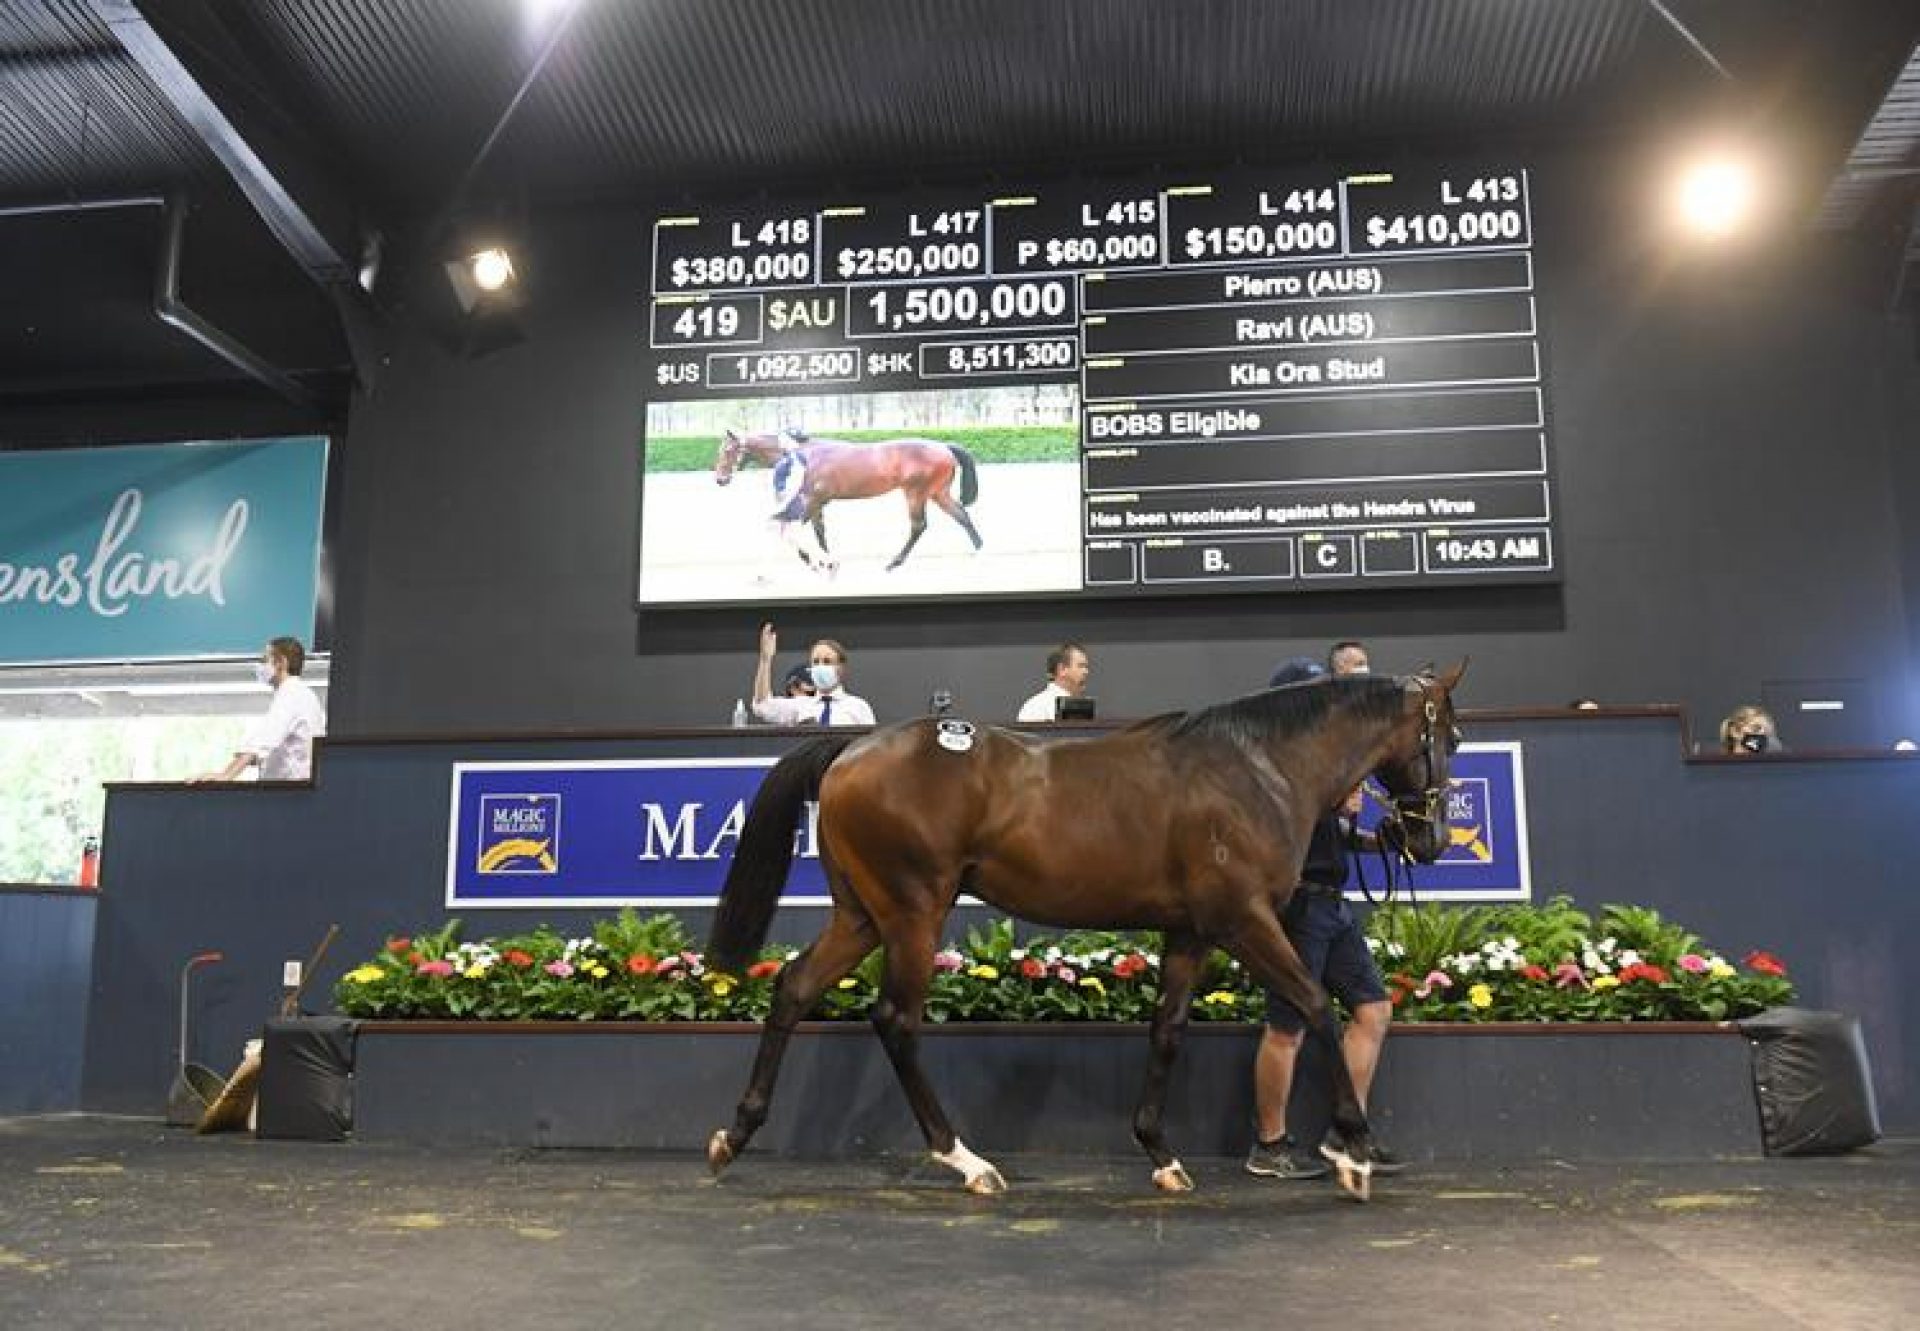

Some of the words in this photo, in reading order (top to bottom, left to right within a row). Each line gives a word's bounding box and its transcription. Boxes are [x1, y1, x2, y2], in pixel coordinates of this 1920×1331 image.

[1259, 193, 1279, 215] L
[1284, 188, 1334, 213] 414
[1441, 181, 1462, 204] L
[1466, 177, 1519, 202] 413
[909, 214, 927, 237] L
[934, 211, 979, 234] 417
[1082, 204, 1101, 226] L
[1106, 200, 1156, 223] 415
[732, 222, 750, 247] L
[757, 219, 810, 245] 418
[1185, 221, 1336, 259] $150,000
[1366, 210, 1521, 248] $410,000
[837, 243, 979, 277] $250,000
[1018, 240, 1038, 265] P
[1046, 233, 1156, 266] $60,000
[671, 254, 810, 286] $380,000
[1225, 275, 1301, 298] Pierro
[1307, 267, 1382, 297] (AUS)
[673, 305, 739, 338] 419
[768, 299, 835, 331] $AU
[869, 282, 1066, 329] 1,500,000
[1236, 316, 1294, 341] Ravi
[1300, 312, 1374, 342] (AUS)
[657, 364, 700, 385] $US
[736, 353, 854, 382] 1,092,500
[867, 353, 912, 373] $HK
[949, 343, 1071, 371] 8,511,300
[1230, 362, 1271, 386] Kia
[1276, 360, 1321, 383] Ora
[1326, 357, 1386, 381] Stud
[1091, 413, 1163, 437] BOBS
[1169, 408, 1261, 436] Eligible
[1090, 511, 1122, 527] Has
[1126, 511, 1168, 526] been
[1170, 506, 1262, 525] vaccinated
[1266, 503, 1329, 522] against
[1330, 502, 1360, 518] the
[1428, 497, 1476, 516] Virus
[1203, 548, 1231, 572] B.
[1316, 543, 1338, 567] C
[1435, 538, 1496, 562] 10:43
[1502, 536, 1540, 559] AM
[493, 808, 546, 823] MAGIC
